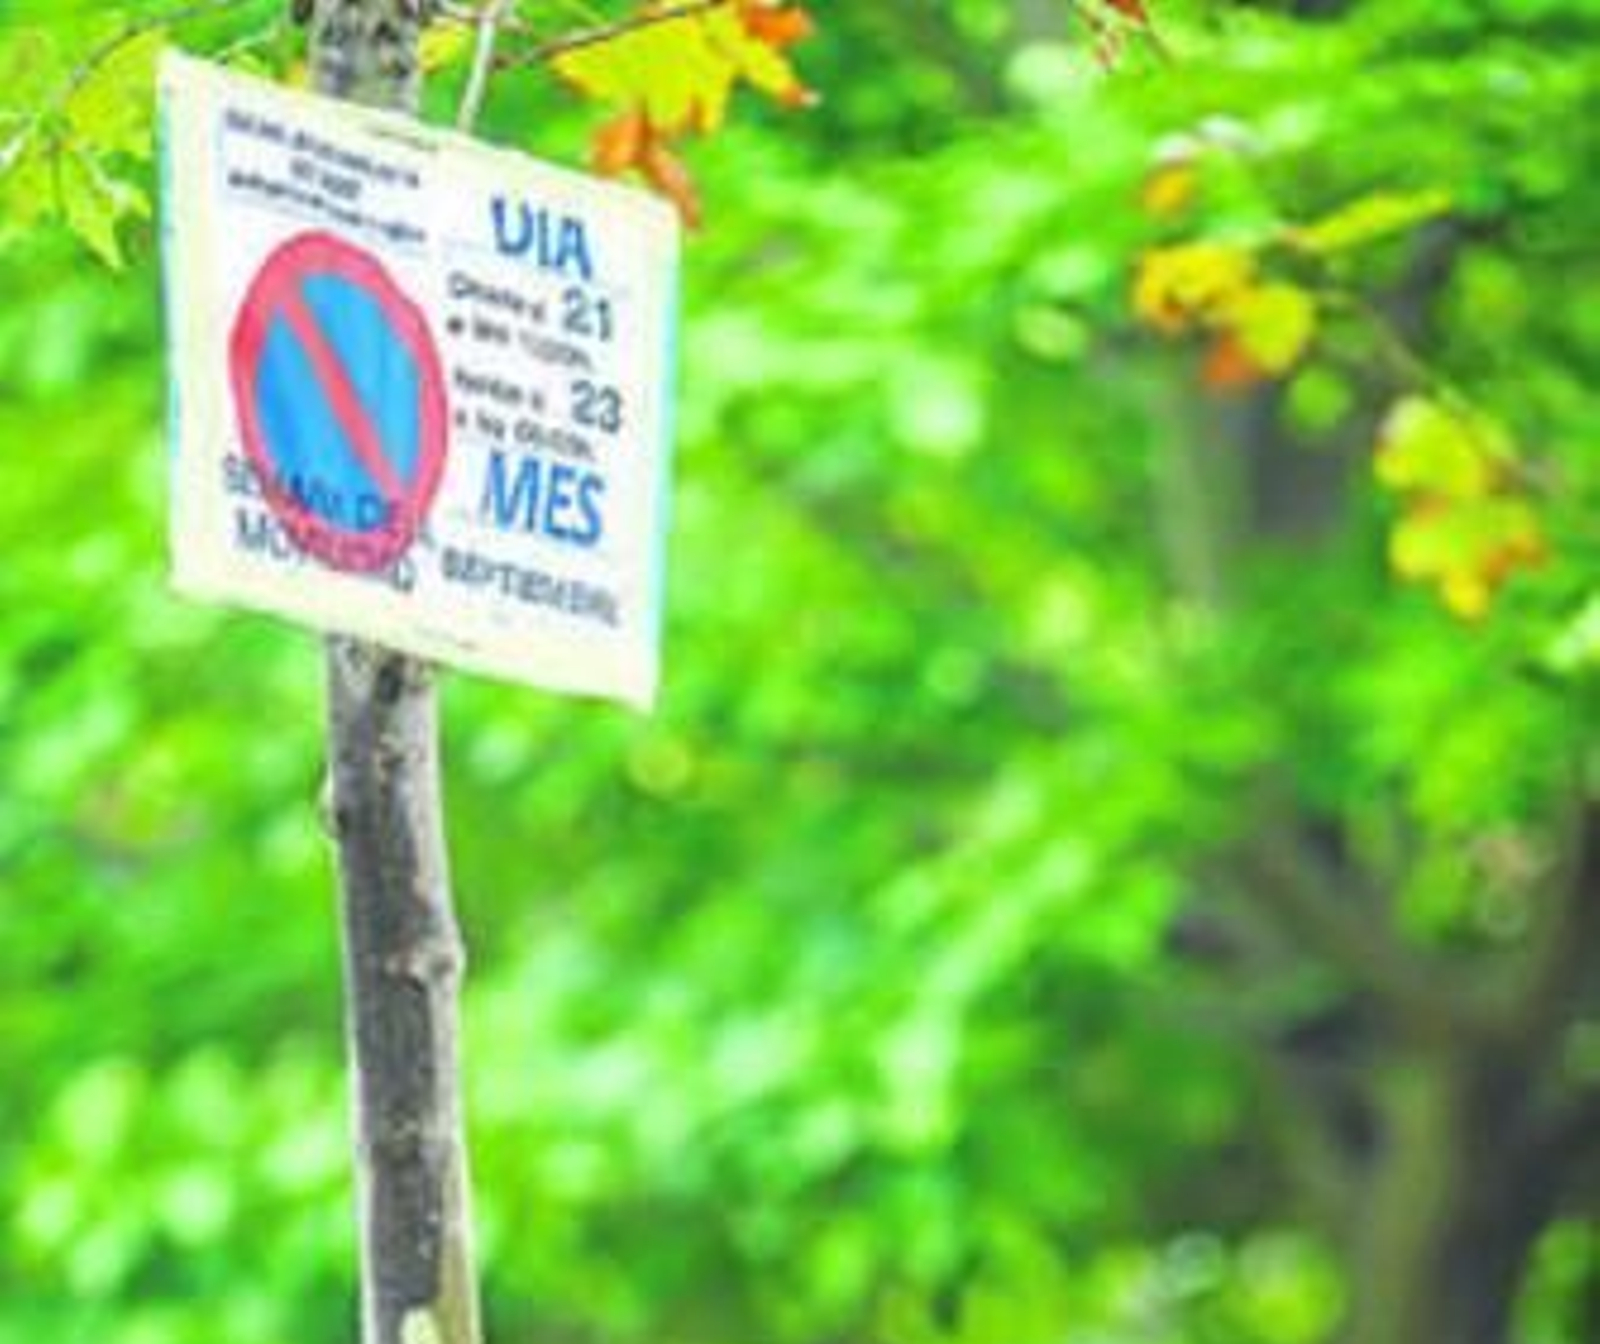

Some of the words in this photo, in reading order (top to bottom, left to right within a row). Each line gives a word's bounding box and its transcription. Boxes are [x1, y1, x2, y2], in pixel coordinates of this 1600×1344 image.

[563, 286, 612, 341] 21
[571, 379, 622, 434] 23
[481, 450, 605, 547] MES
